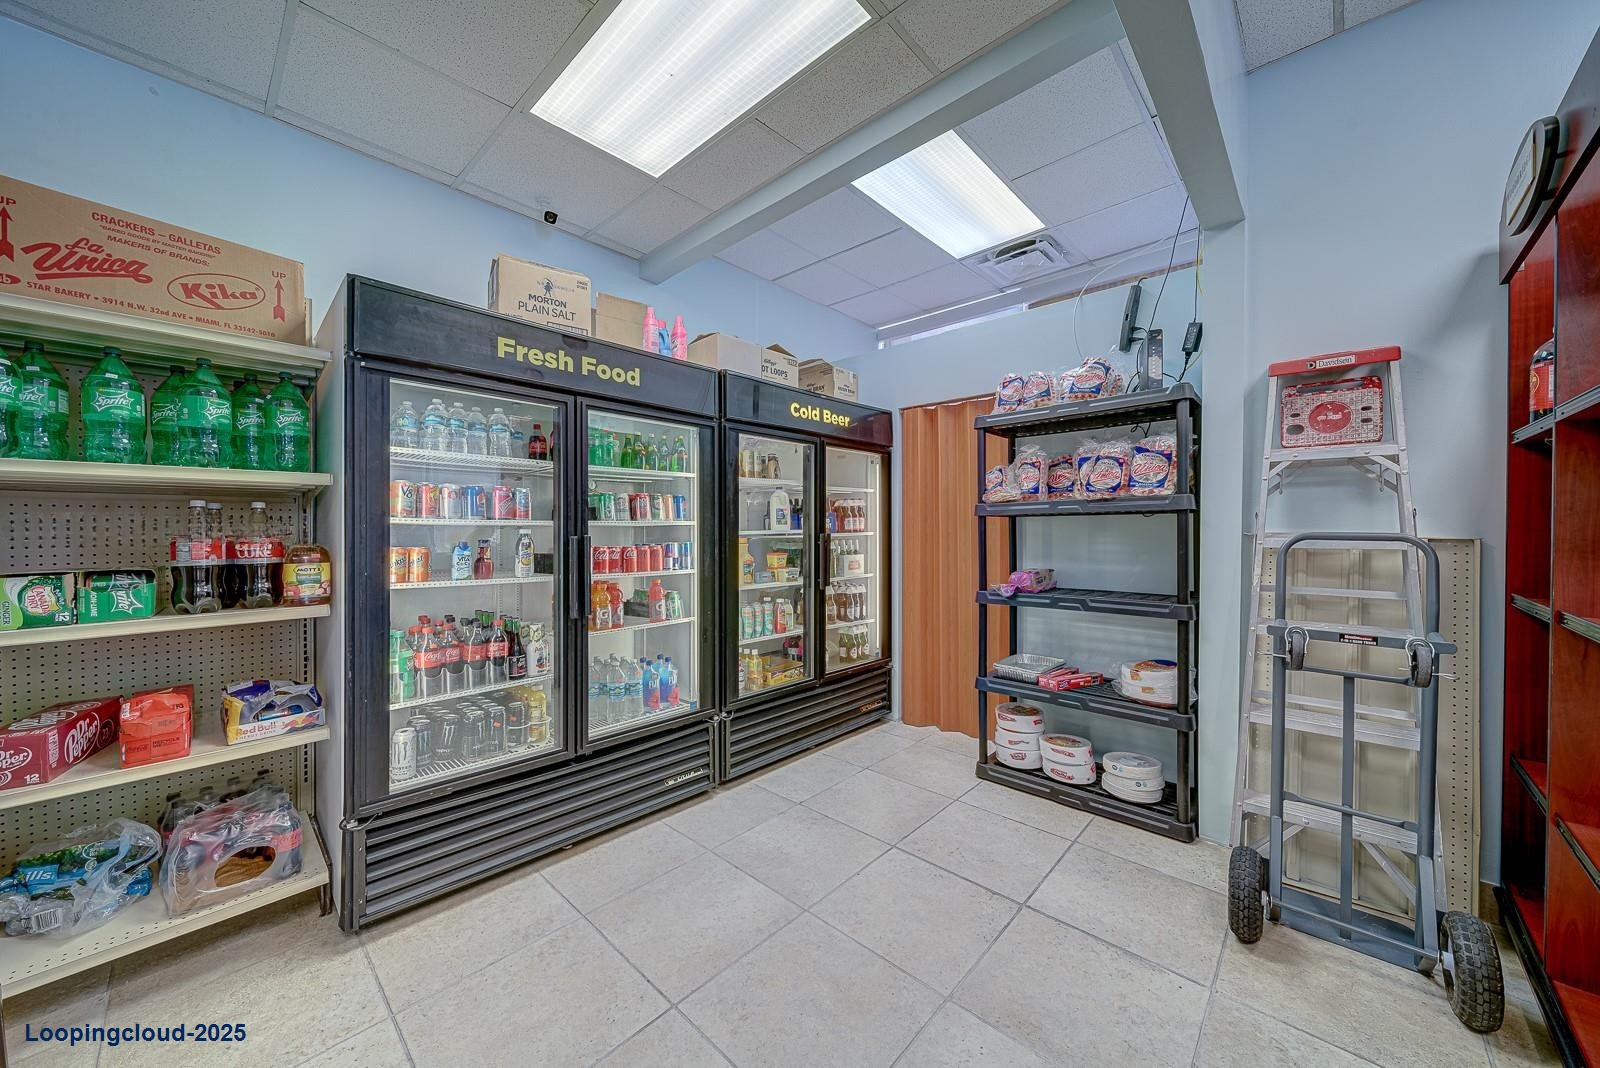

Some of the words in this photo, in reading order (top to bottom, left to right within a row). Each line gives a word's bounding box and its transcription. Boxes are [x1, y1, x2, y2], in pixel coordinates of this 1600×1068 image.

[91, 211, 156, 236] CRACKERS
[168, 233, 221, 255] GALLETAS
[64, 237, 105, 254] La
[106, 235, 151, 252] MAKERS
[153, 247, 167, 255] OF
[20, 242, 151, 276] Unica
[271, 270, 287, 279] UP
[26, 281, 52, 293] STAR
[54, 287, 92, 301] BAKERY
[101, 296, 126, 309] 3914
[149, 306, 170, 317] 32nd
[171, 311, 187, 320] AVE
[179, 282, 258, 310] Kika
[528, 293, 567, 309] MORTON
[518, 300, 550, 316] PLAIN
[551, 308, 577, 321] SALT
[497, 336, 575, 373] Fresh
[581, 356, 641, 387] Food
[770, 367, 789, 378] LOOPS
[96, 396, 131, 408] Sprite
[277, 413, 302, 425] Sprite
[790, 402, 820, 422] Cold
[823, 407, 850, 428] Beer
[401, 486, 413, 498] V8
[27, 595, 39, 610] DRY
[31, 586, 50, 615] CANADA
[75, 717, 90, 738] Dr
[236, 727, 256, 736] Red
[257, 721, 276, 731] Bull
[67, 721, 98, 764] Pepper
[24, 773, 40, 781] 12
